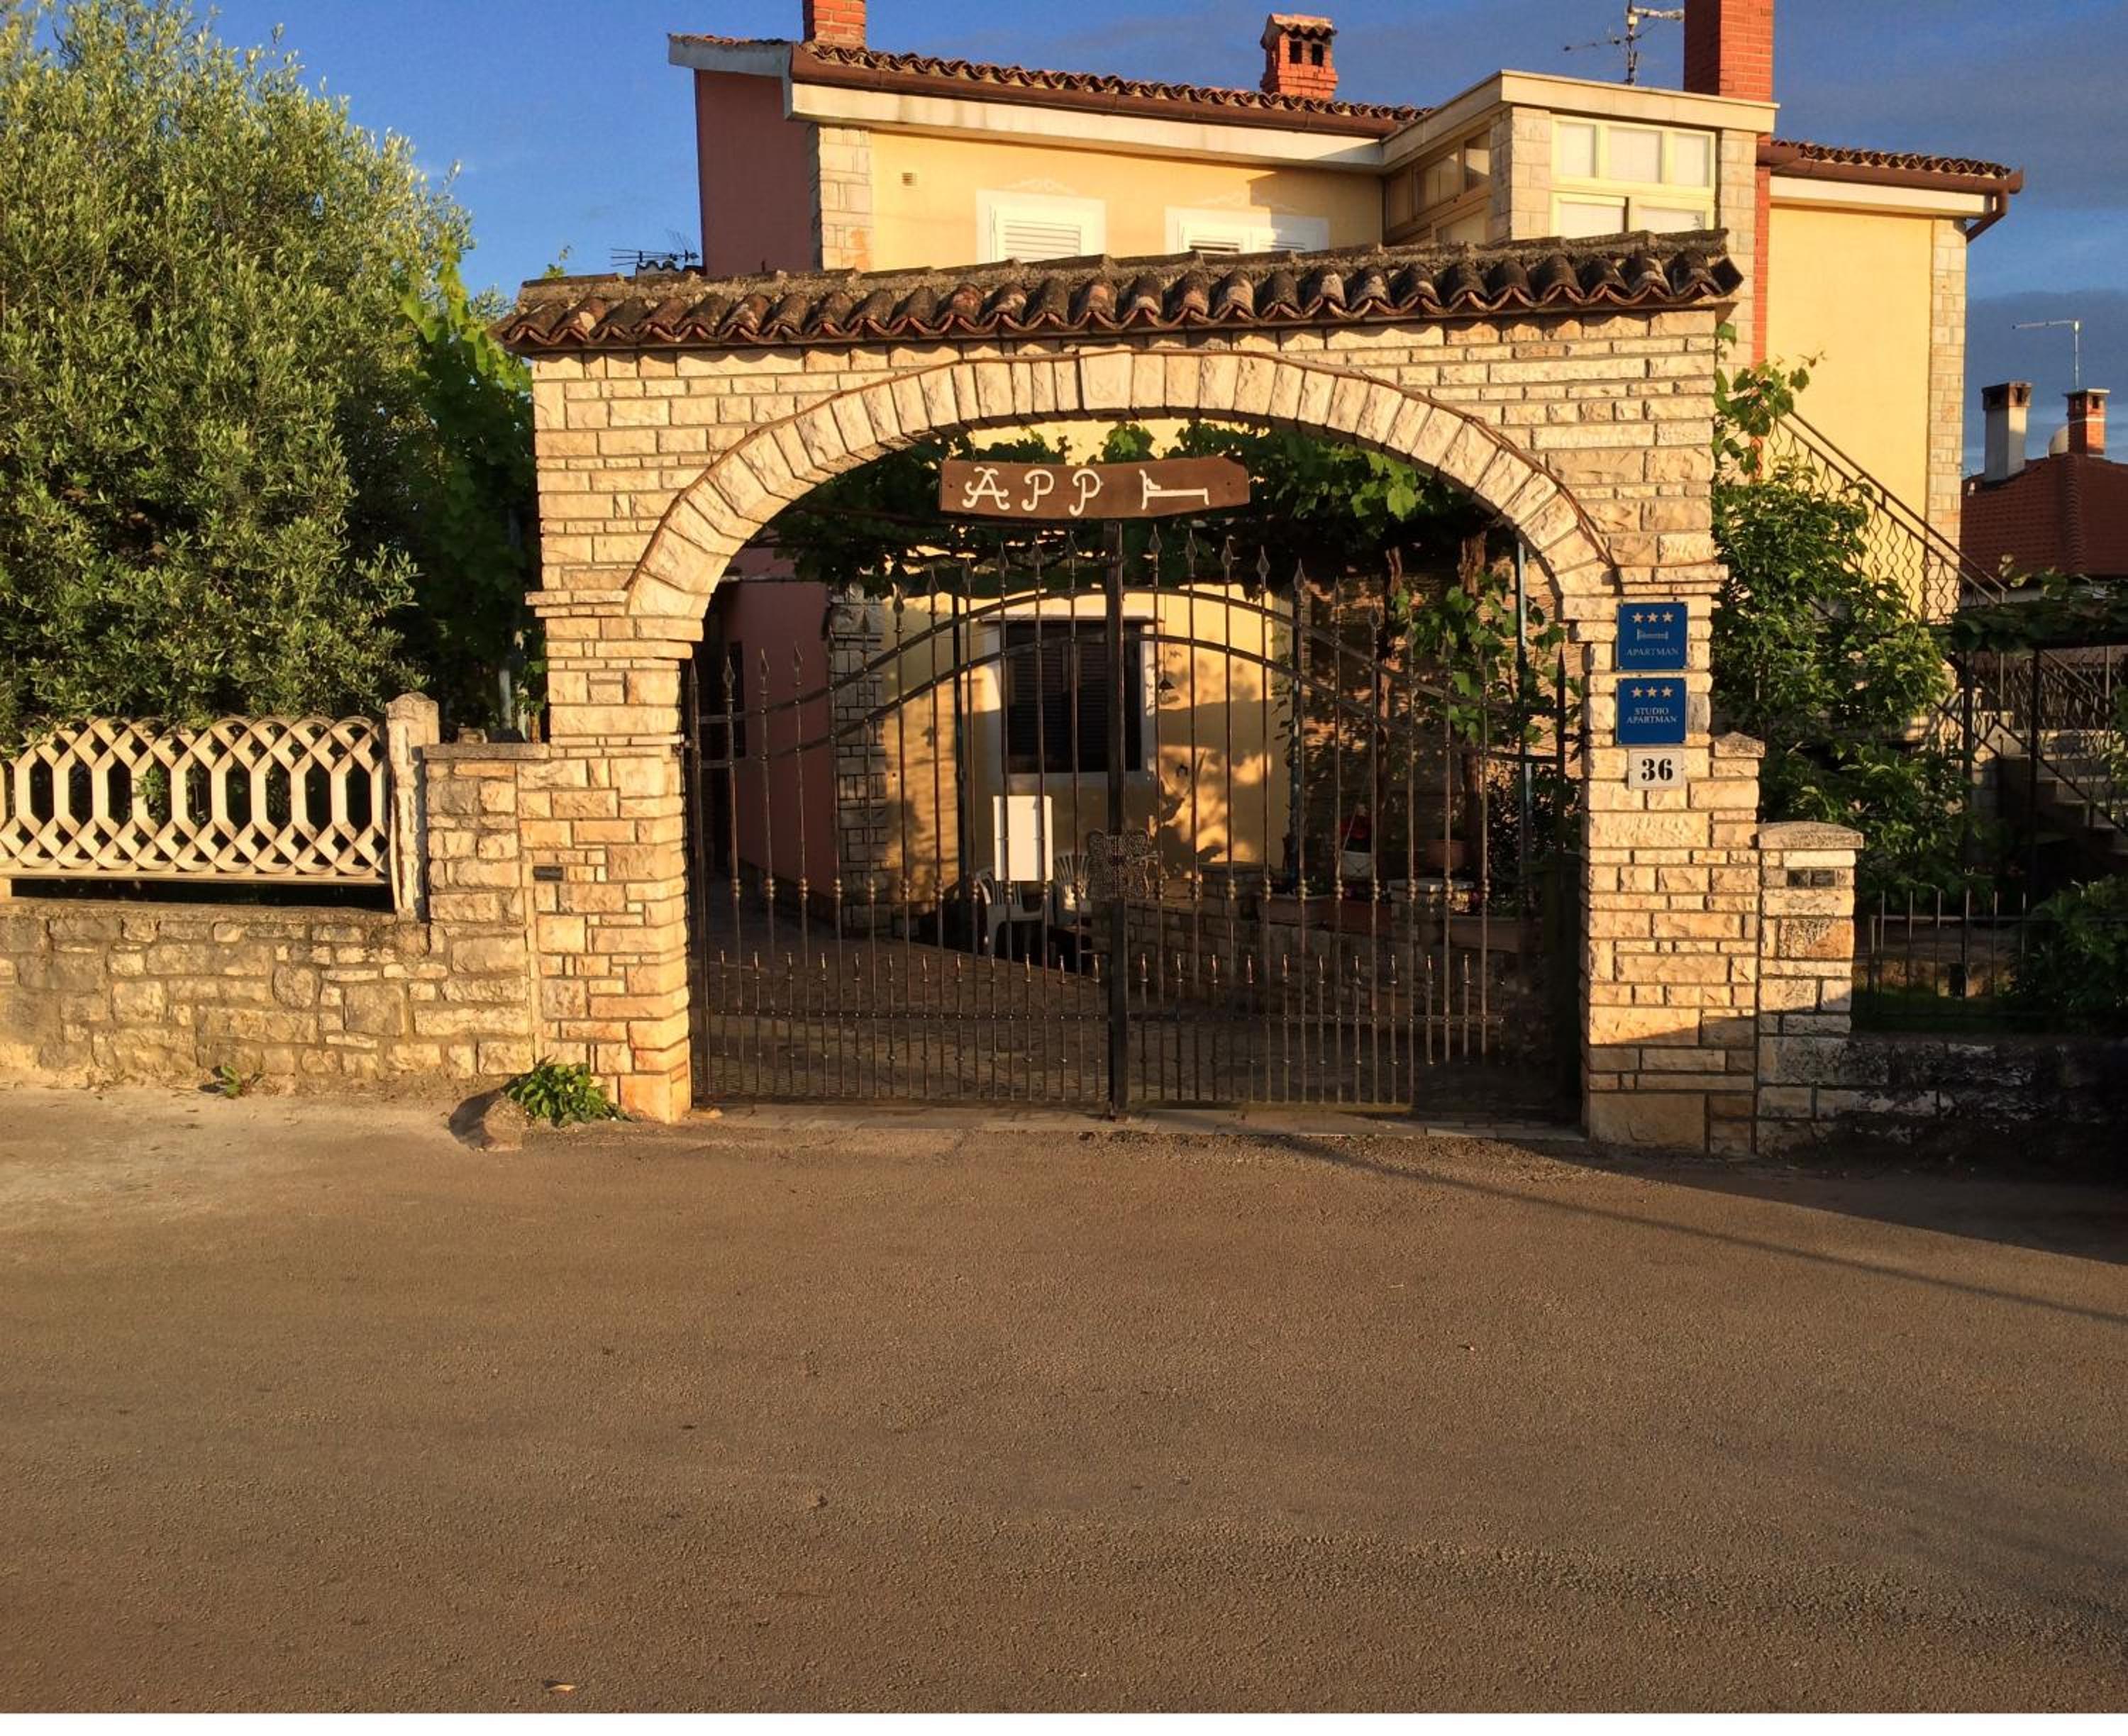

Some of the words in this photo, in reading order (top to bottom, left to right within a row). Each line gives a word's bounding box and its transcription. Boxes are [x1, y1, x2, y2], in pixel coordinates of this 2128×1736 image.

[1627, 647, 1679, 656] APARTMAN
[1634, 707, 1669, 716] STUDIO
[1627, 716, 1678, 724] APARTMAN
[1641, 758, 1673, 781] 36
